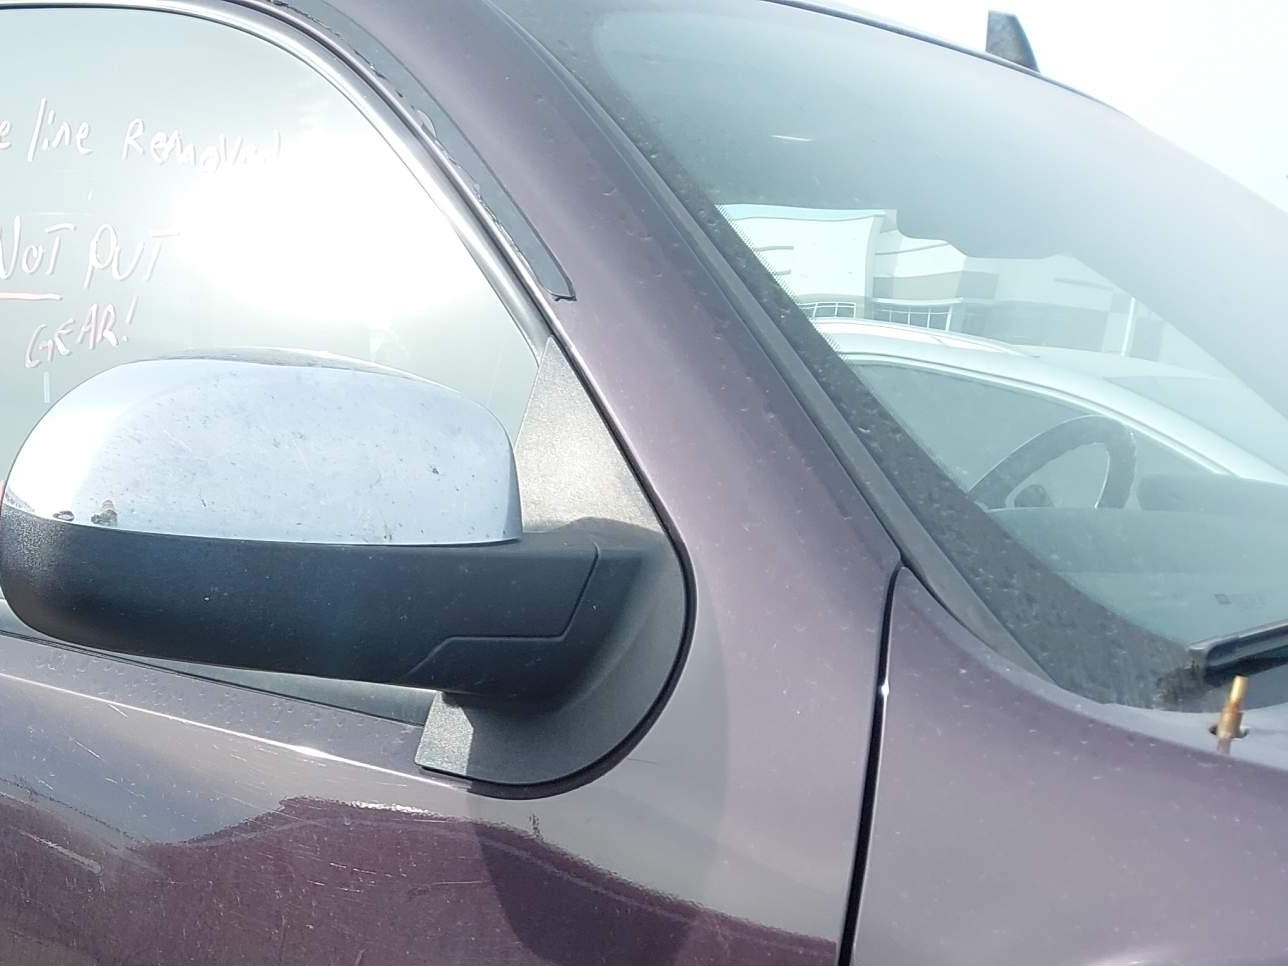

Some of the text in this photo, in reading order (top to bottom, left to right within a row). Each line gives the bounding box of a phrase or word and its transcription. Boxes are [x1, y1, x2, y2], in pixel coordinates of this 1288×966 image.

[27, 98, 93, 162] line
[83, 223, 181, 289] PUT
[24, 295, 140, 369] GEAR!
